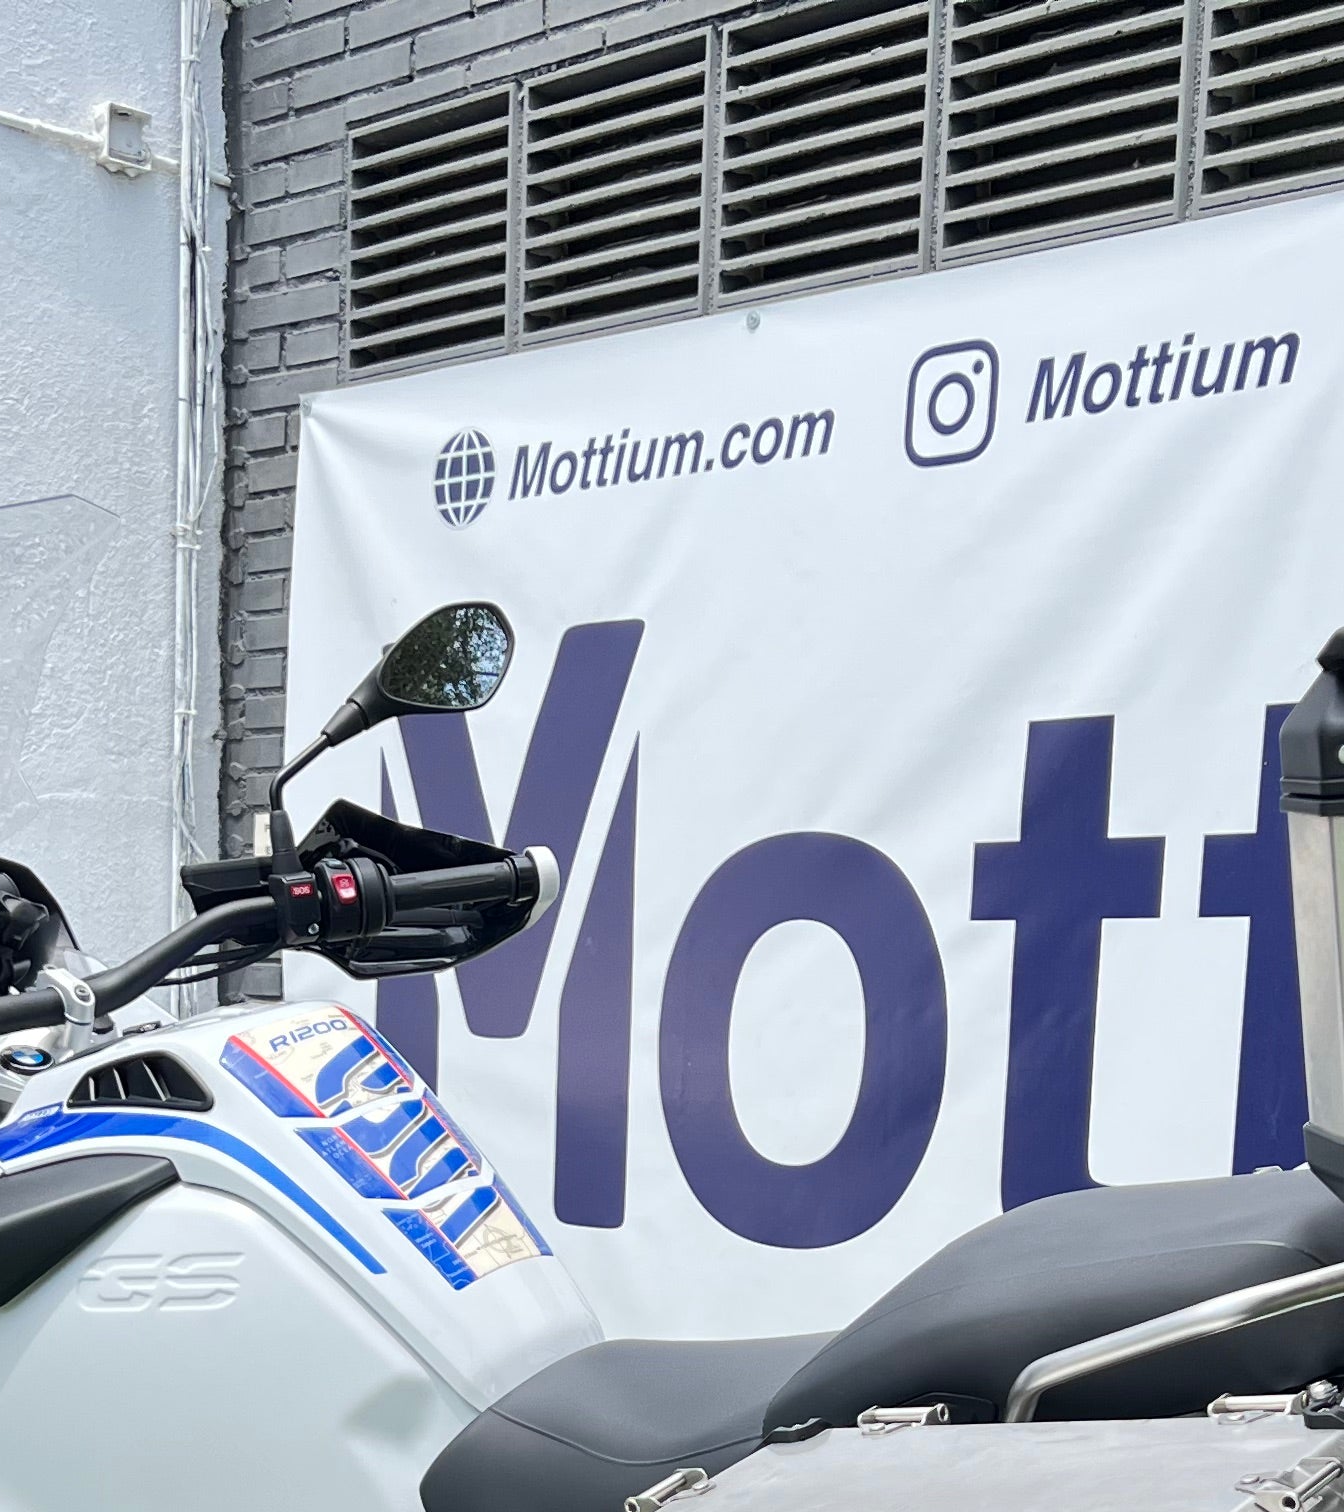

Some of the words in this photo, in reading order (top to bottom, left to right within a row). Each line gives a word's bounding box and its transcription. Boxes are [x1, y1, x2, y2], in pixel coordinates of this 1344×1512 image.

[1025, 331, 1301, 423] Mottium
[508, 408, 835, 501] Mottium.com
[269, 1018, 349, 1053] R1200
[78, 1251, 246, 1313] GS
